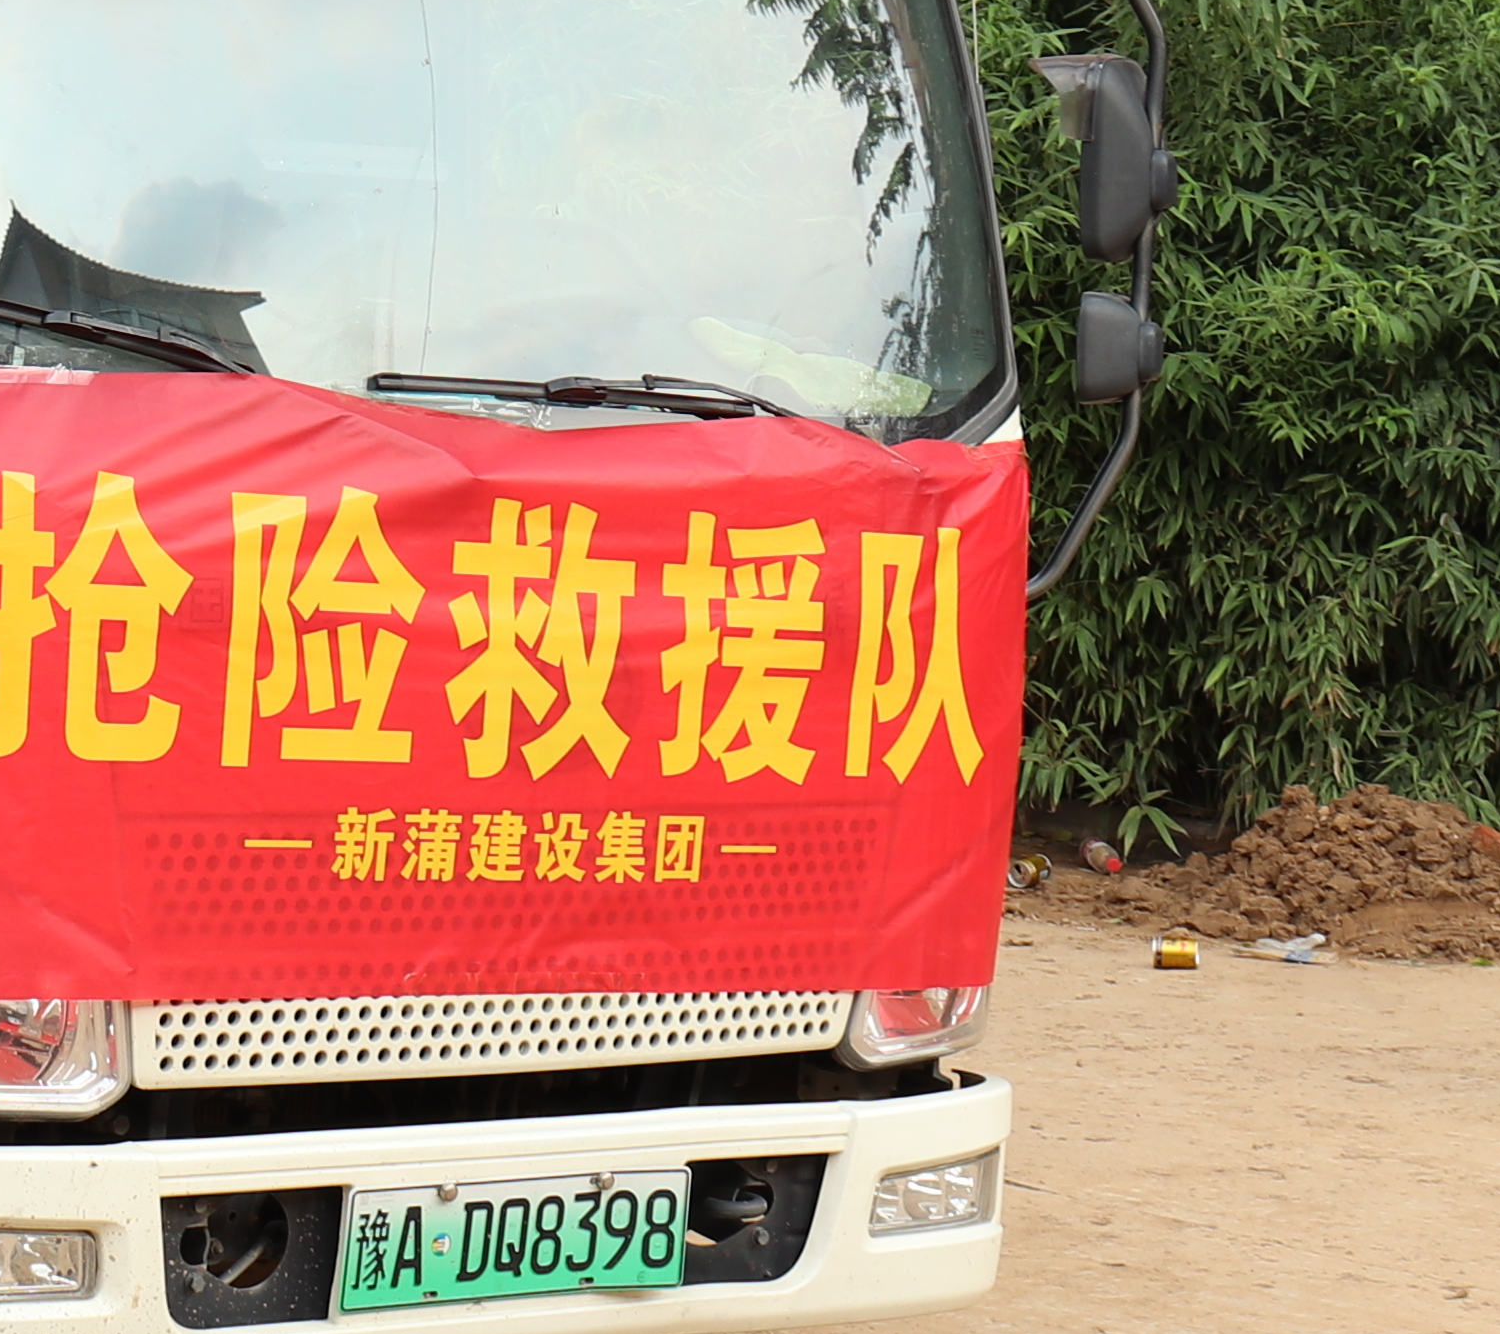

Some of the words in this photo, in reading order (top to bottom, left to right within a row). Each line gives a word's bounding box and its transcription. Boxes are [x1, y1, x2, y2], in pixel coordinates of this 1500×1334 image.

[330, 807, 707, 885] 新蒲建设集团
